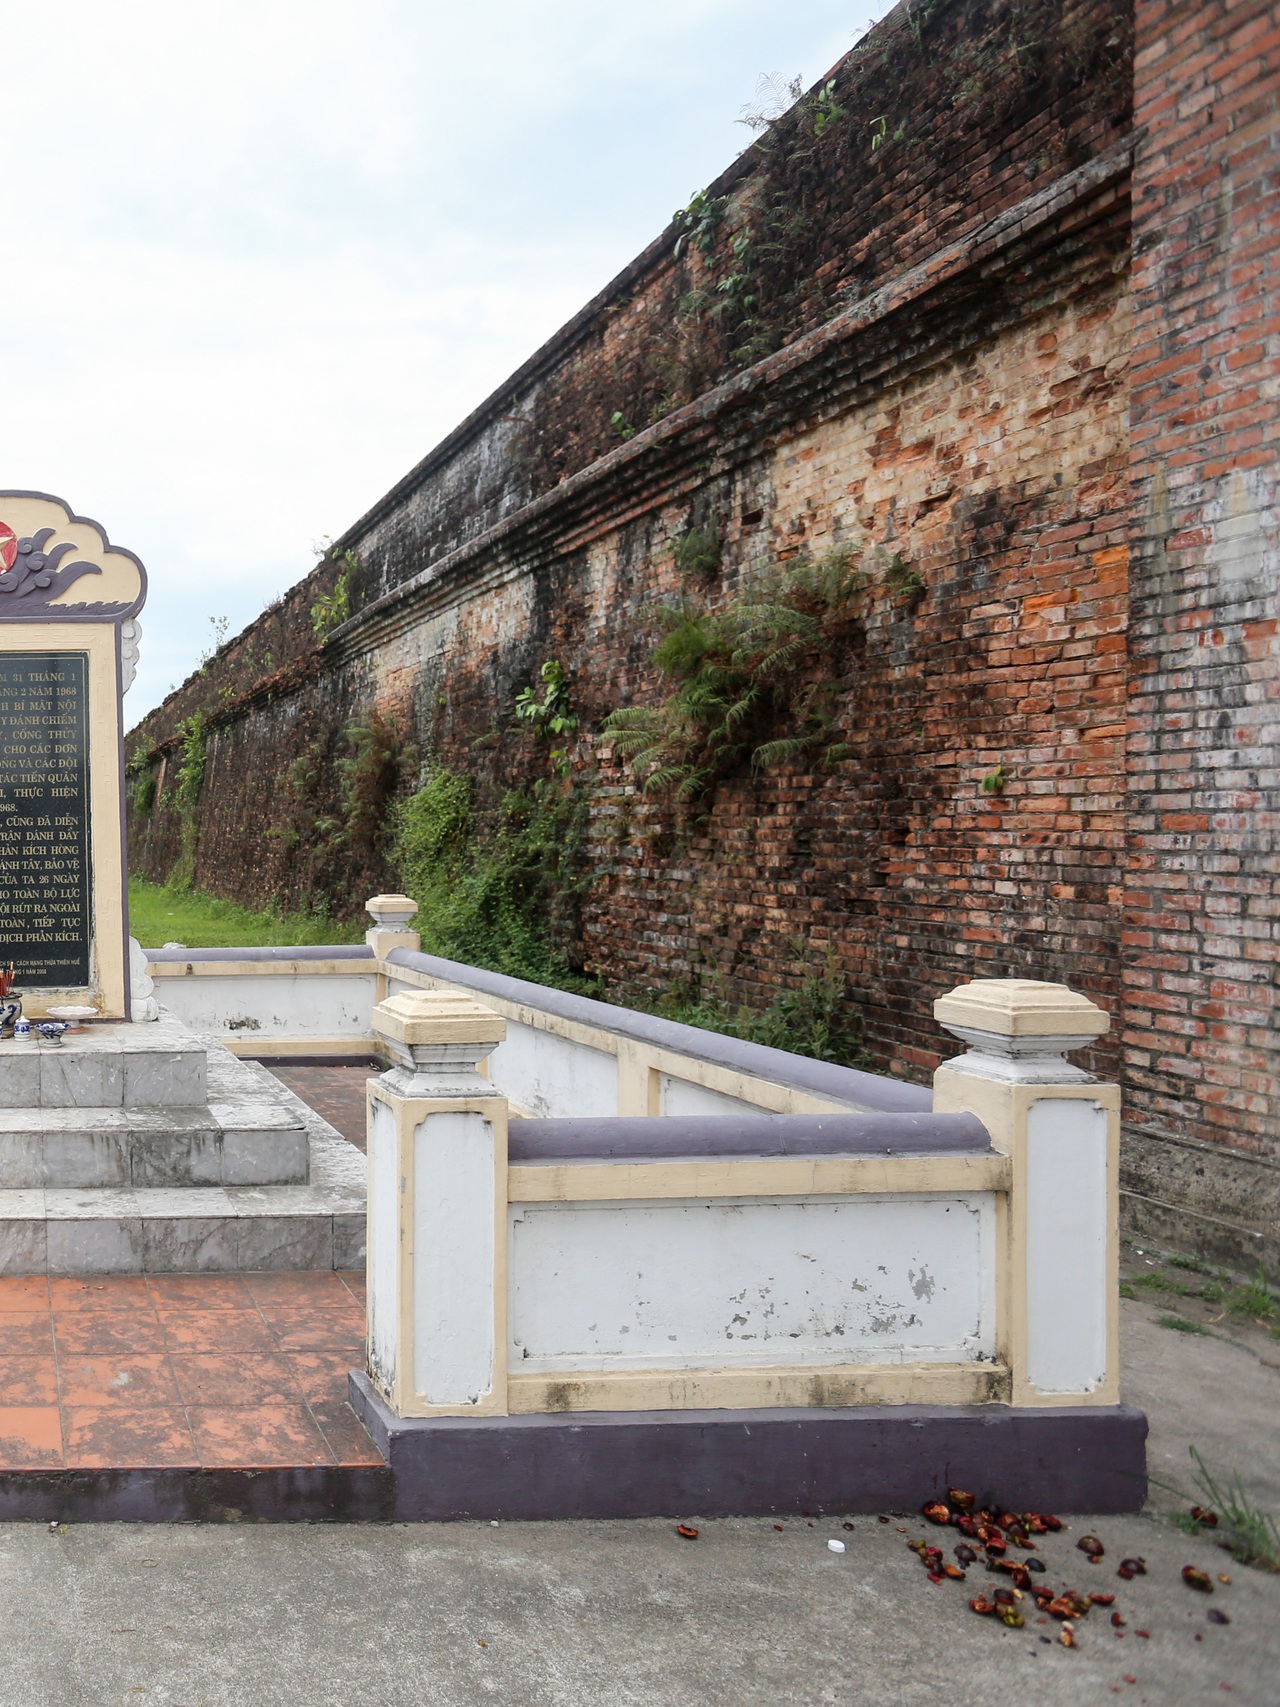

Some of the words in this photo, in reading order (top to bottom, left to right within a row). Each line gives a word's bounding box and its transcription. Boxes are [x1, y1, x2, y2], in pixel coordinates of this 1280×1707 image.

[28, 670, 65, 681] THÁNG
[29, 686, 52, 695] NĂM
[56, 686, 76, 696] 1968
[14, 700, 24, 710] BÍ
[30, 700, 53, 712] MẬT
[58, 699, 76, 712] NỘI
[10, 714, 39, 724] ĐÁNH
[42, 712, 76, 724] CHIẾM
[13, 728, 42, 739] CỐNG
[4, 746, 26, 754] CHO
[30, 743, 50, 753] CÁC
[55, 744, 77, 753] ĐƠN
[19, 757, 32, 768] VÀ
[35, 757, 56, 767] CÁC
[58, 756, 77, 769] ĐỘI
[20, 770, 45, 782] TIẾN
[48, 771, 78, 784] QUÂN
[14, 787, 43, 799] THỰC
[51, 786, 78, 798] HIỆN
[6, 816, 33, 826] CŨNG
[37, 815, 51, 826] ĐÃ
[55, 813, 78, 825] DIỄN
[26, 830, 53, 840] ĐÁNH
[59, 827, 79, 840] ĐẨY
[22, 844, 46, 855] KÍCH
[51, 844, 79, 854] HÒNG
[45, 857, 64, 869] BẢO
[66, 858, 79, 870] VỆ
[53, 872, 79, 883] NGÀY
[13, 888, 39, 898] TOÀN
[44, 888, 57, 900] BỘ
[61, 888, 80, 900] LỰC
[12, 902, 32, 913] RÚT
[34, 904, 47, 913] RA
[50, 901, 80, 912] NGOÀI
[33, 915, 55, 927] TIẾP
[61, 918, 80, 928] TỤC
[0, 934, 23, 944] ĐỊCH
[26, 930, 53, 942] PHẢN
